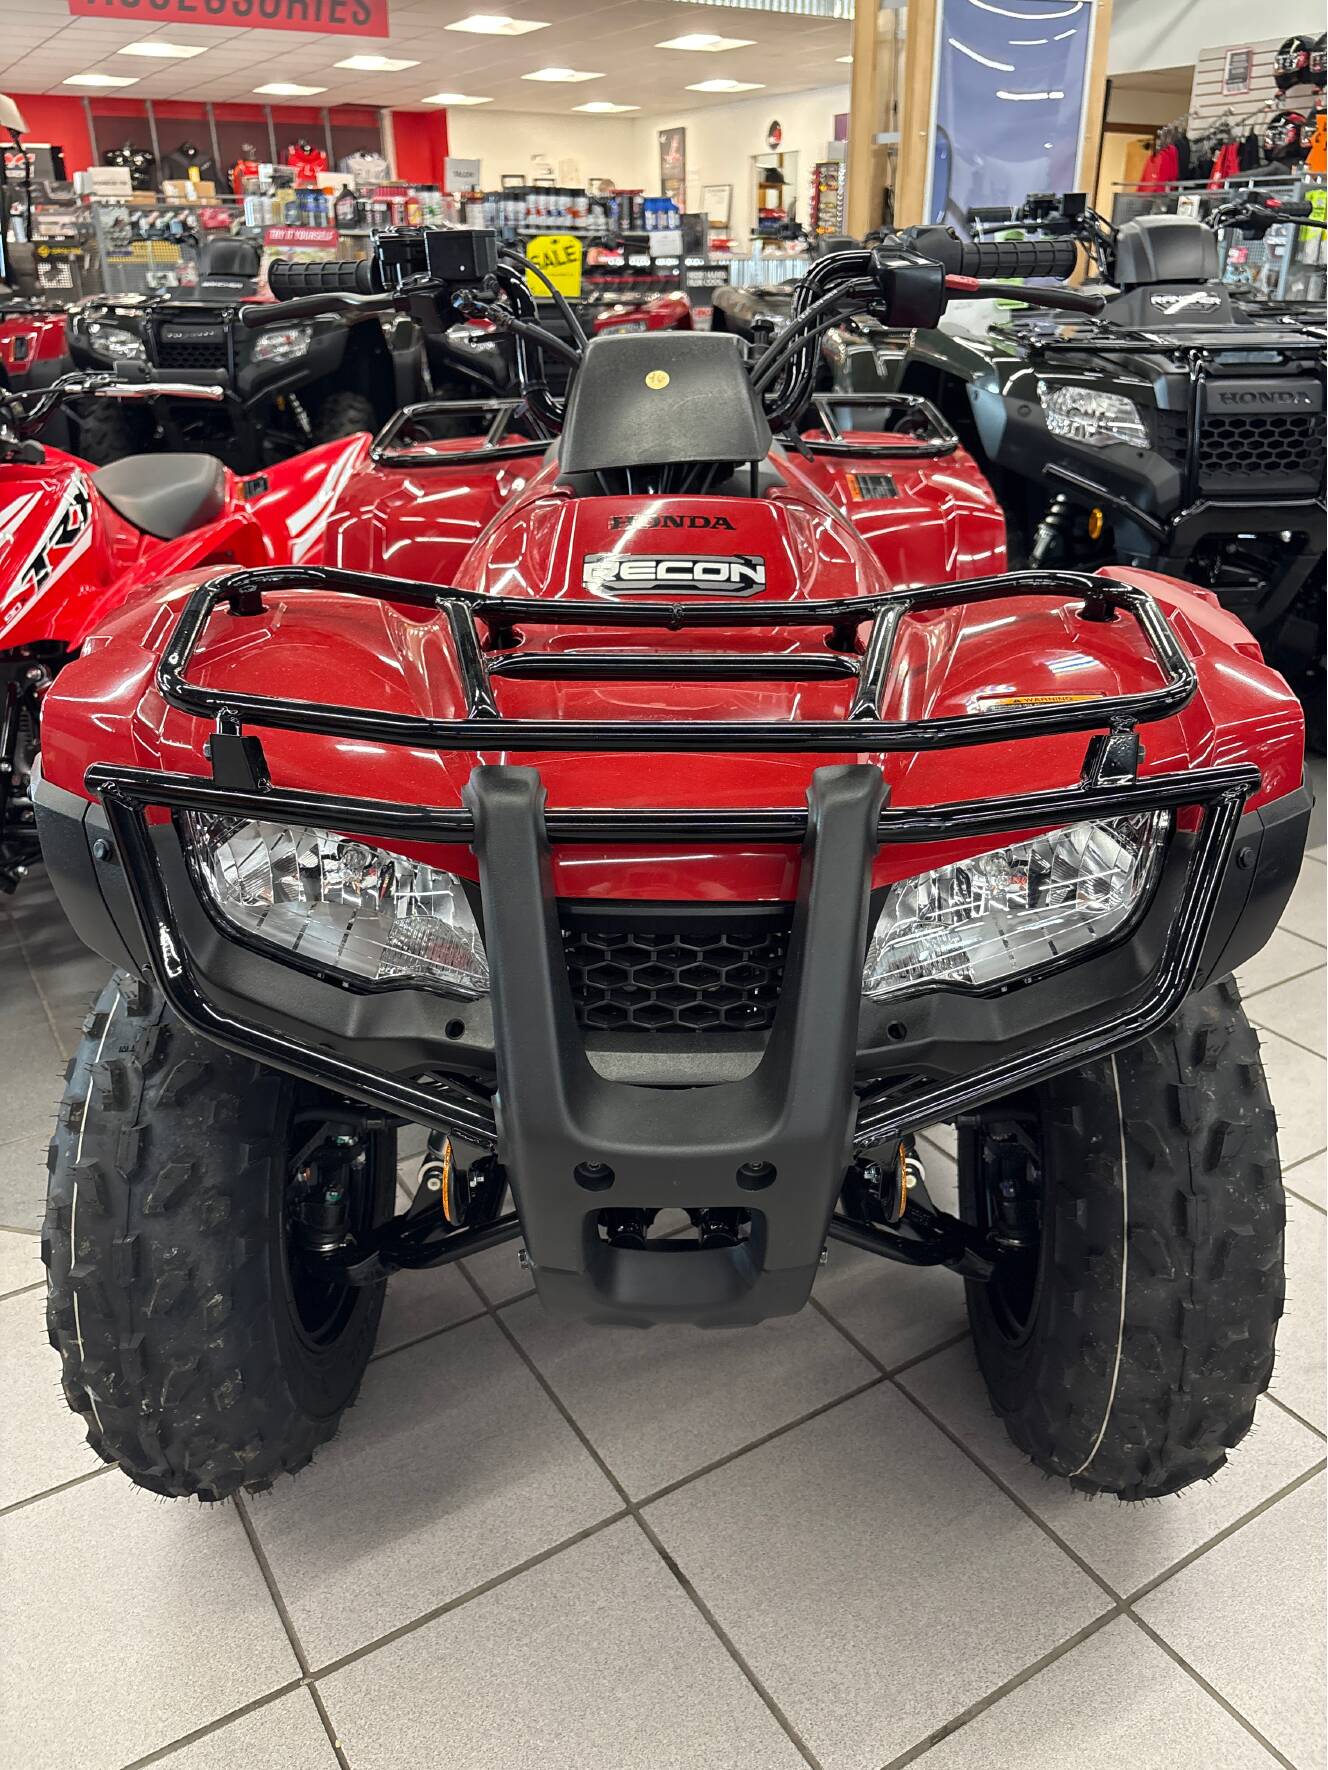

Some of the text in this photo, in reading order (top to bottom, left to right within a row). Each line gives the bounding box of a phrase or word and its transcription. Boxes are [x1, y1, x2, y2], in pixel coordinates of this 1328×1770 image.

[86, 0, 371, 26] SORIES
[530, 245, 577, 269] SALE
[1218, 391, 1313, 405] HONDA
[609, 514, 737, 531] HONDA
[583, 560, 766, 585] RECON
